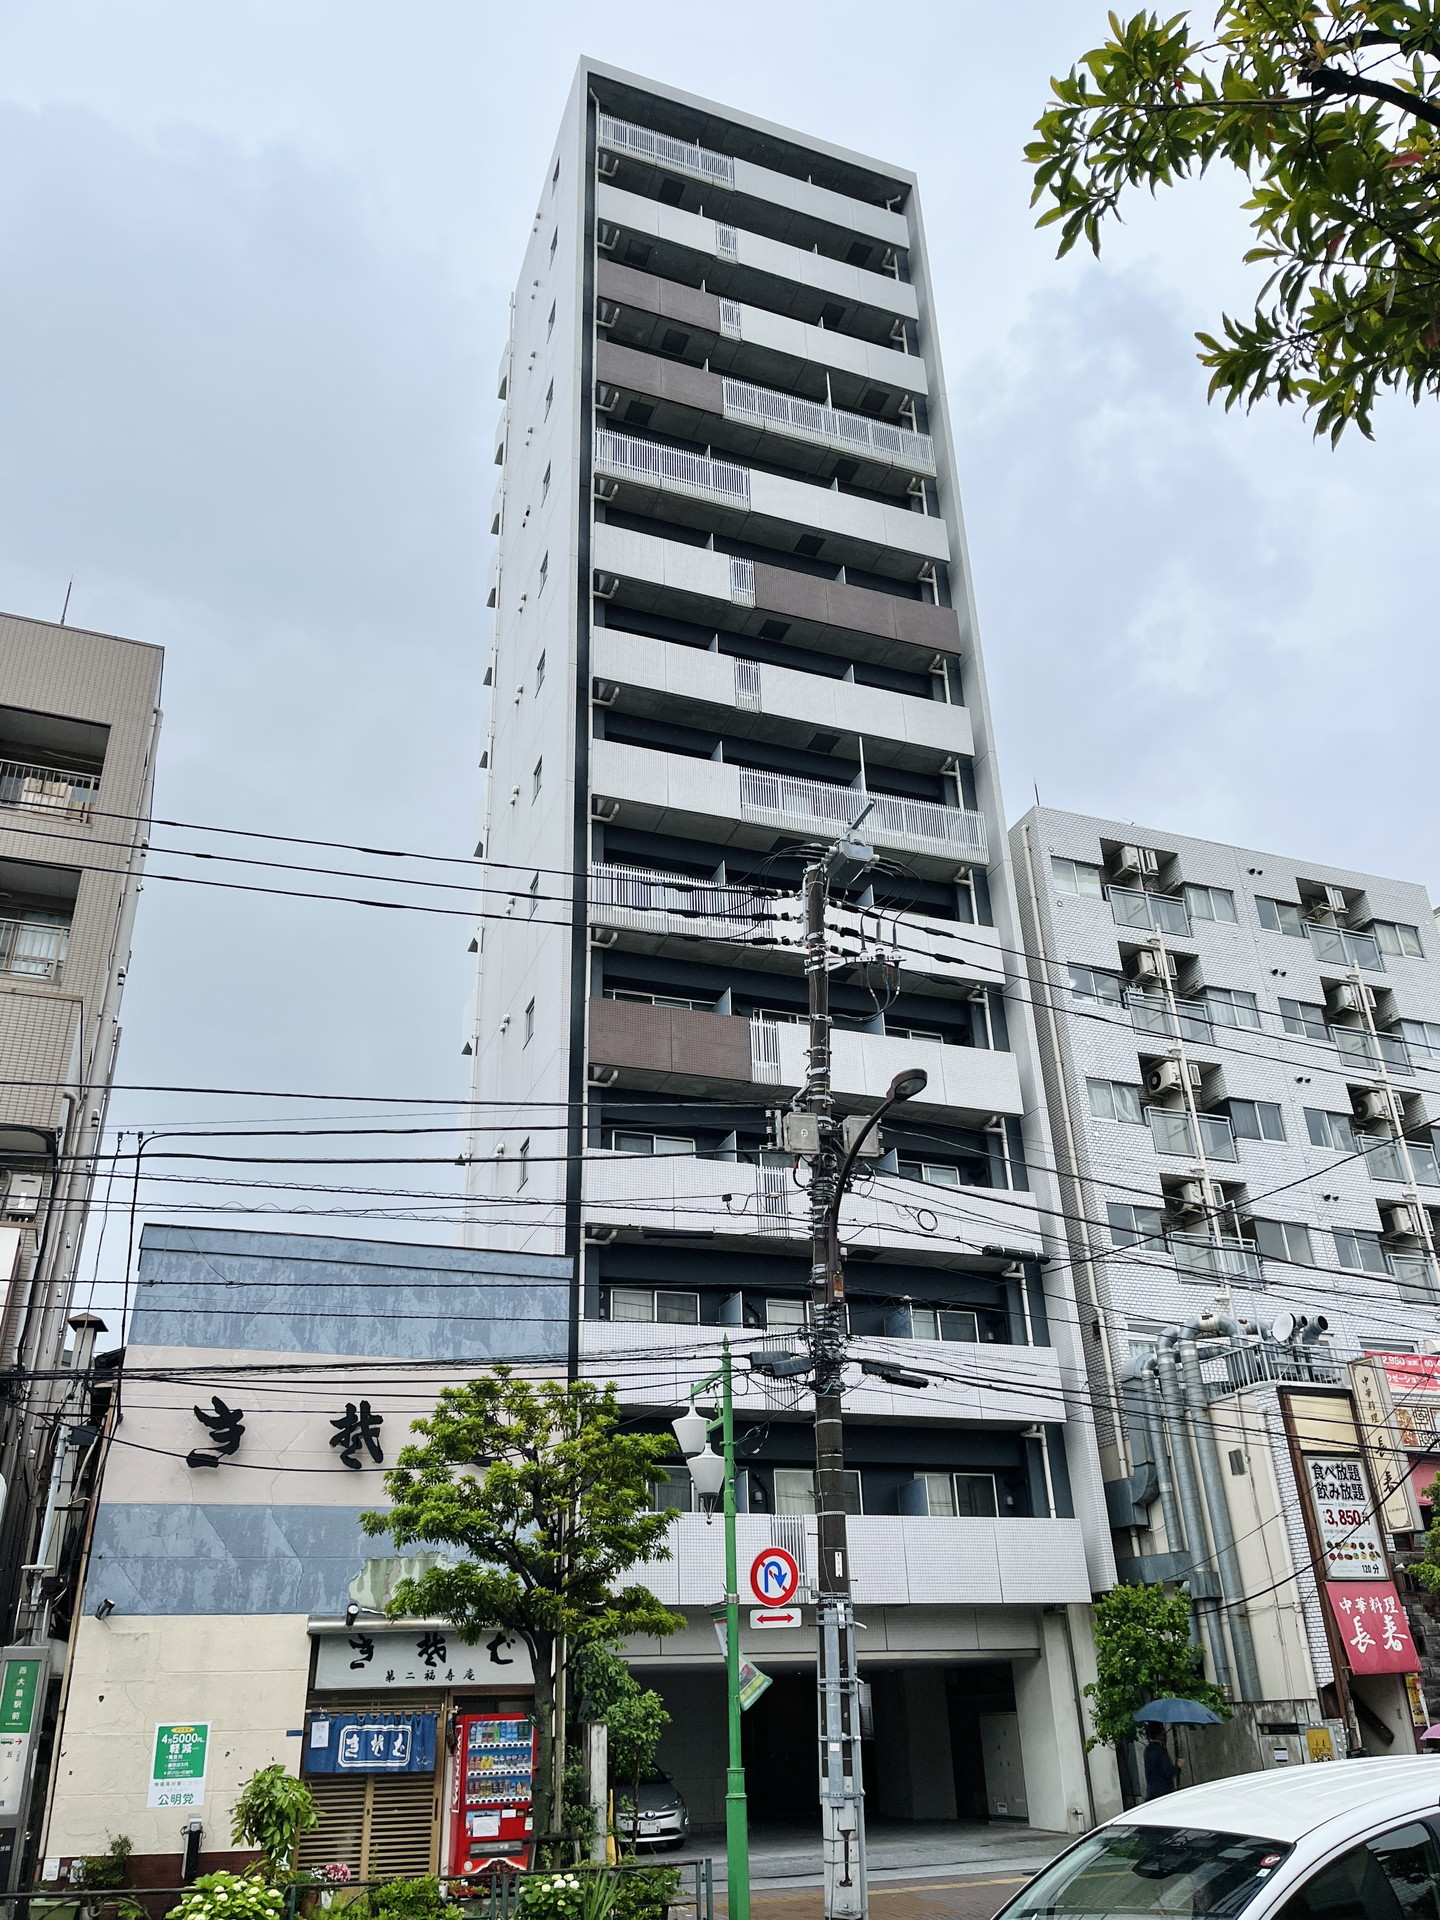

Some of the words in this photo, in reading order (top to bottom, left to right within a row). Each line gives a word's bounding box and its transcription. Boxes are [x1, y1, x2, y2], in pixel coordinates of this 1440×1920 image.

[1310, 1462, 1361, 1482] 食べ放題
[1315, 1482, 1366, 1501] 飲み放題
[1338, 1595, 1400, 1615] 中華料理
[1350, 1615, 1409, 1654] 長春
[384, 1668, 476, 1683] 第二福寿庵
[11, 1666, 28, 1720] 西大島駅前
[158, 1793, 194, 1806] 公明党
